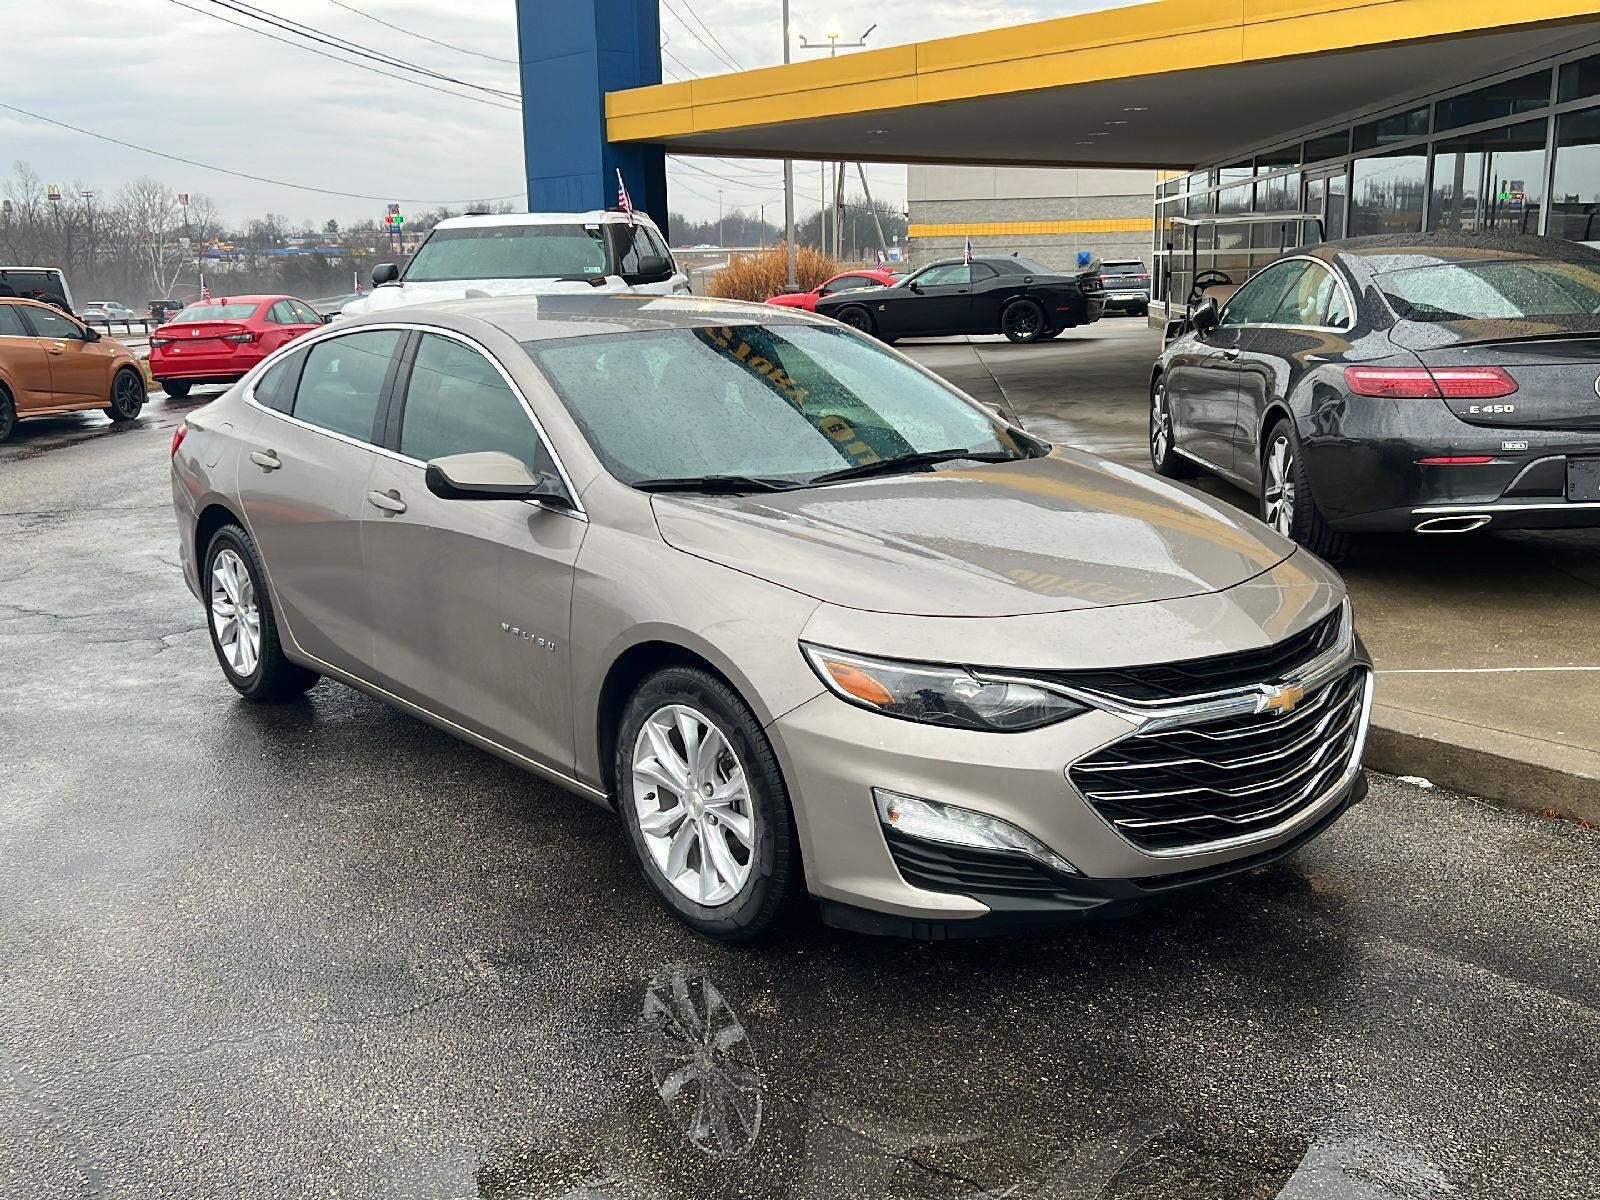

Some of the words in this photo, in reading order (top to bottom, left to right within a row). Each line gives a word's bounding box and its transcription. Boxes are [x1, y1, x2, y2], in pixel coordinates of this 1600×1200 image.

[1469, 405, 1480, 414] E
[1482, 404, 1514, 413] 450
[501, 622, 556, 651] MALIBU
